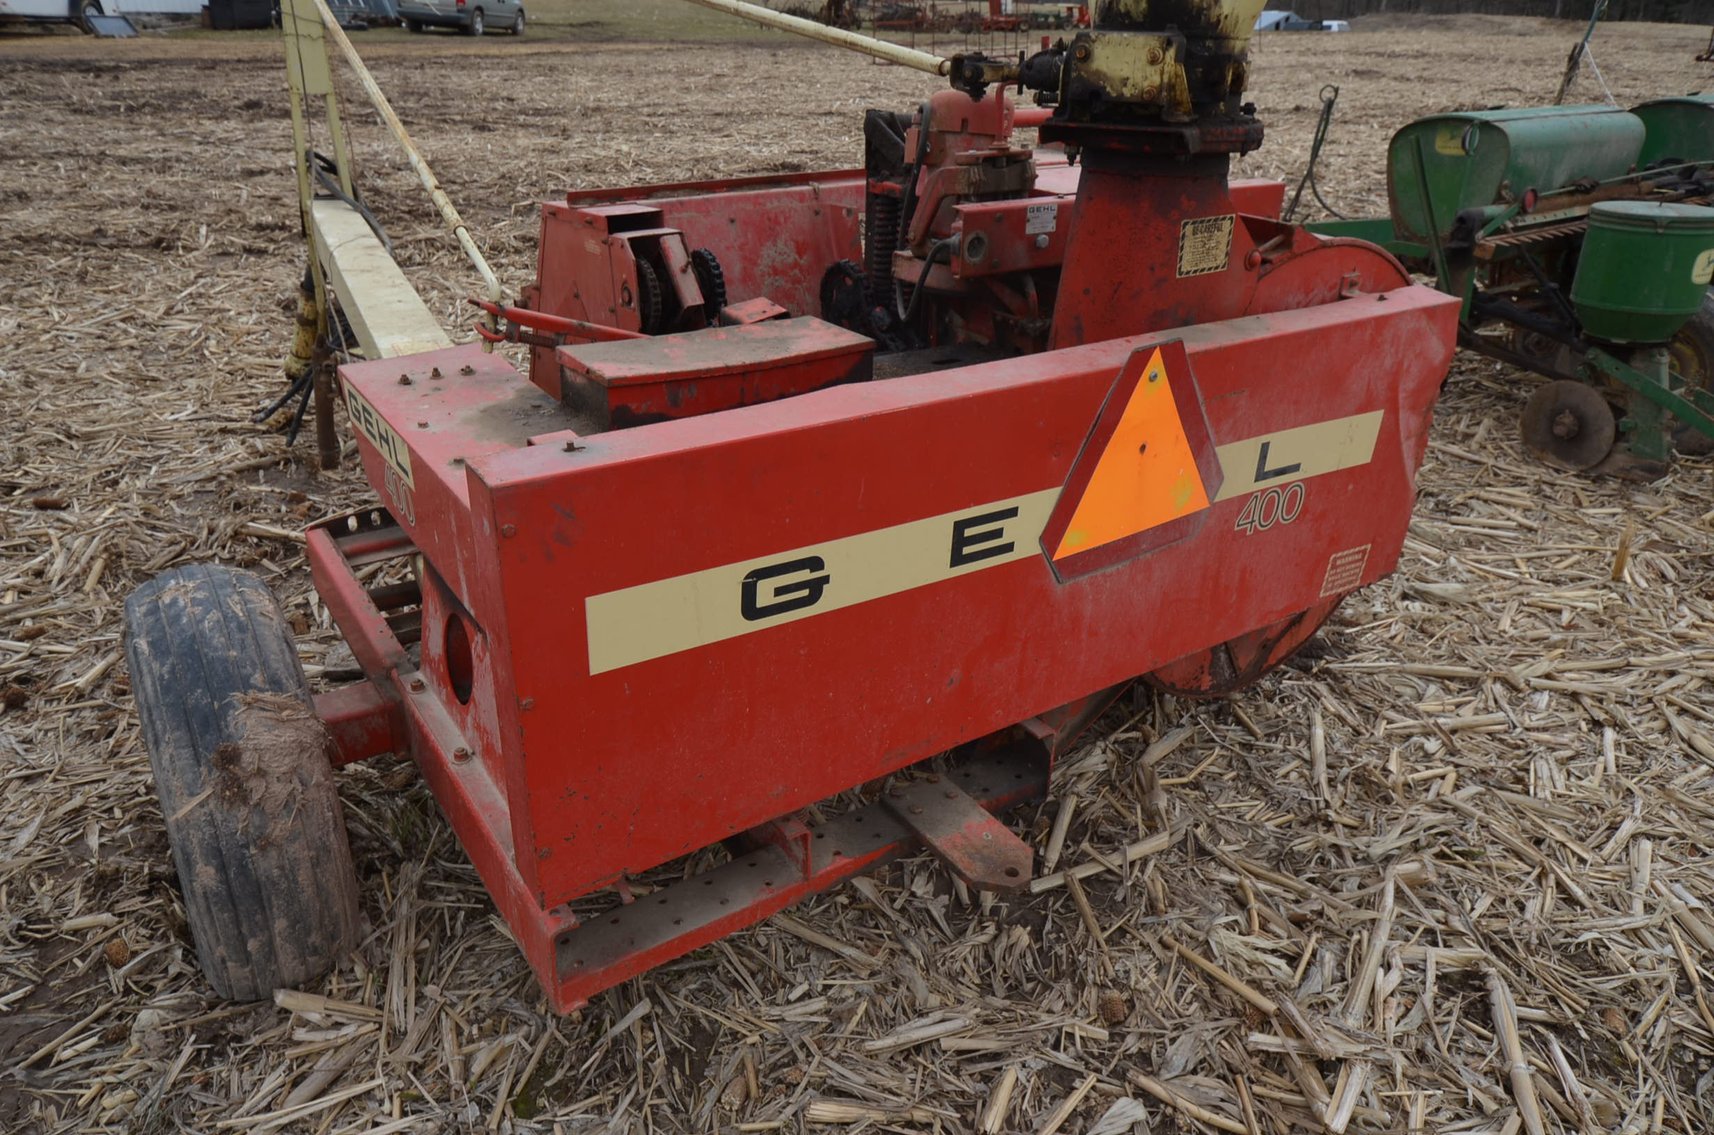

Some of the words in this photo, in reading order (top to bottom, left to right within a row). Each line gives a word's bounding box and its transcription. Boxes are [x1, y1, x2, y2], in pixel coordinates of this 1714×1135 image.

[1029, 205, 1056, 214] GEHL
[347, 388, 410, 479] GEHL
[1234, 481, 1305, 535] 400
